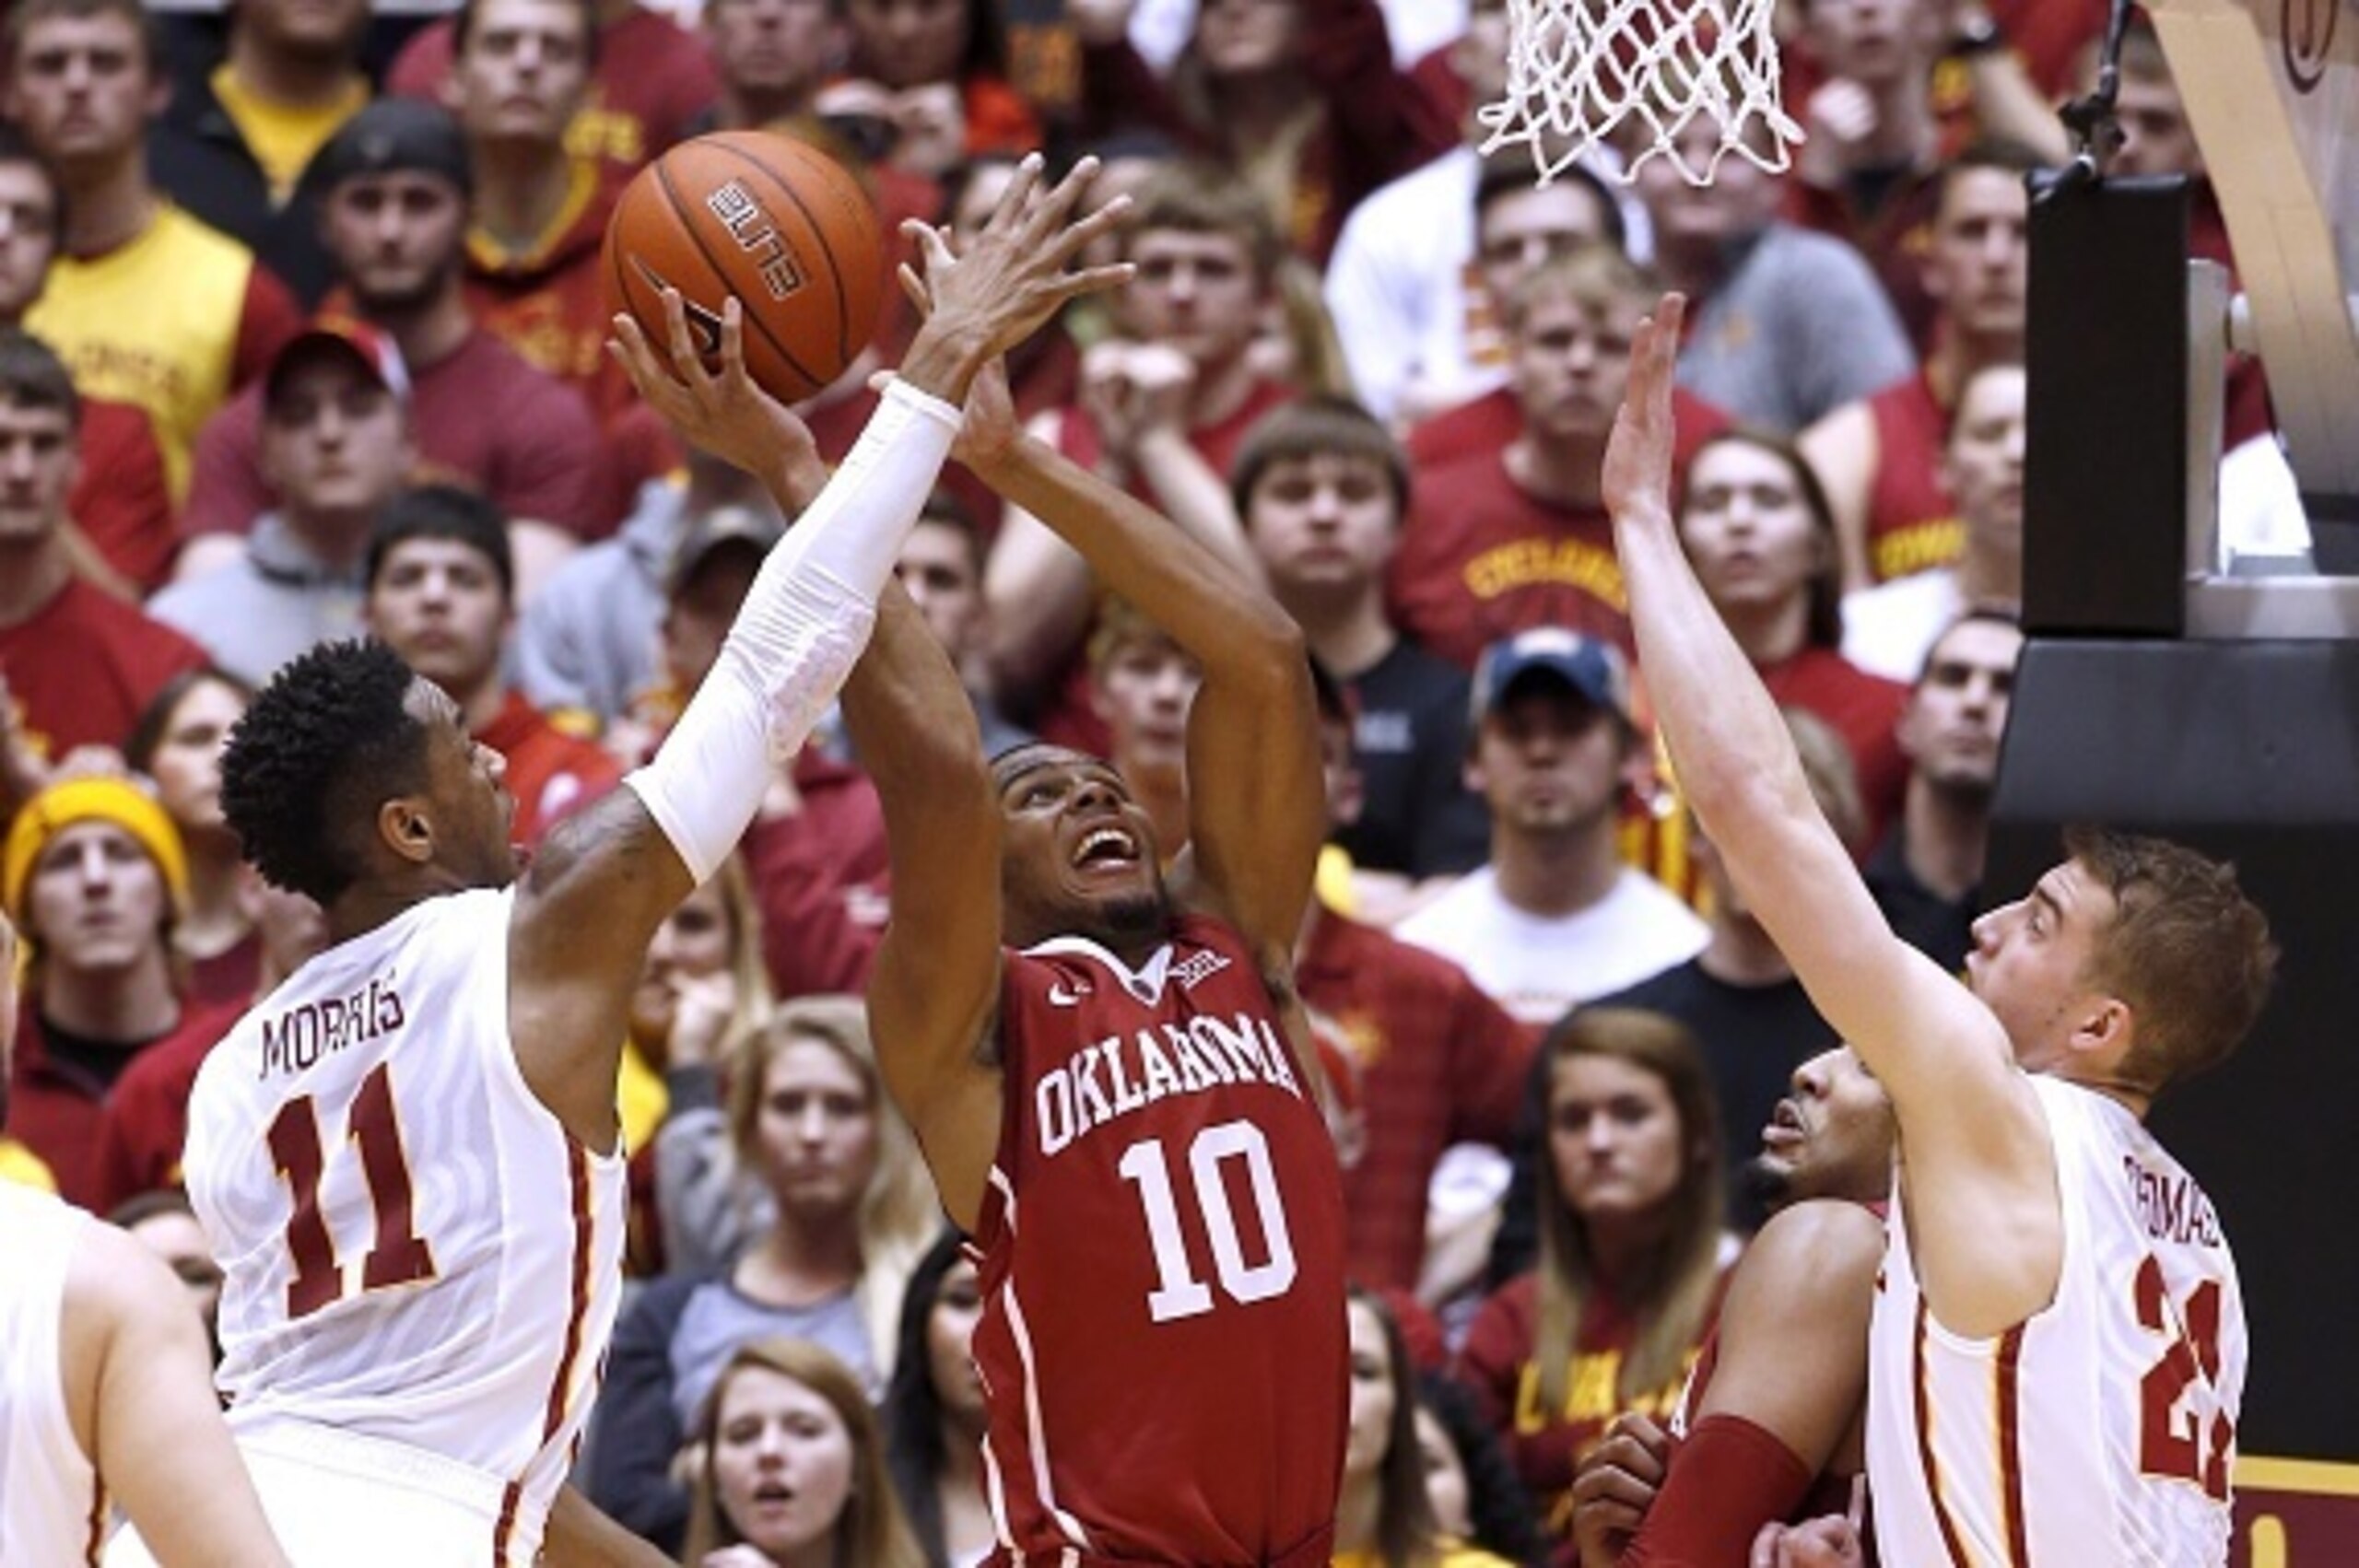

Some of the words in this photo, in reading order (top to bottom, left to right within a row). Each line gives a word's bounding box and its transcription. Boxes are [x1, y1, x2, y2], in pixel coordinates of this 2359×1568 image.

[707, 181, 808, 301] ELITE
[259, 967, 405, 1082] MORRIS
[1036, 1012, 1303, 1157] OKLAHOMA
[265, 1061, 440, 1320] 11
[1118, 1118, 1297, 1322] 10
[2132, 1251, 2234, 1504] 21
